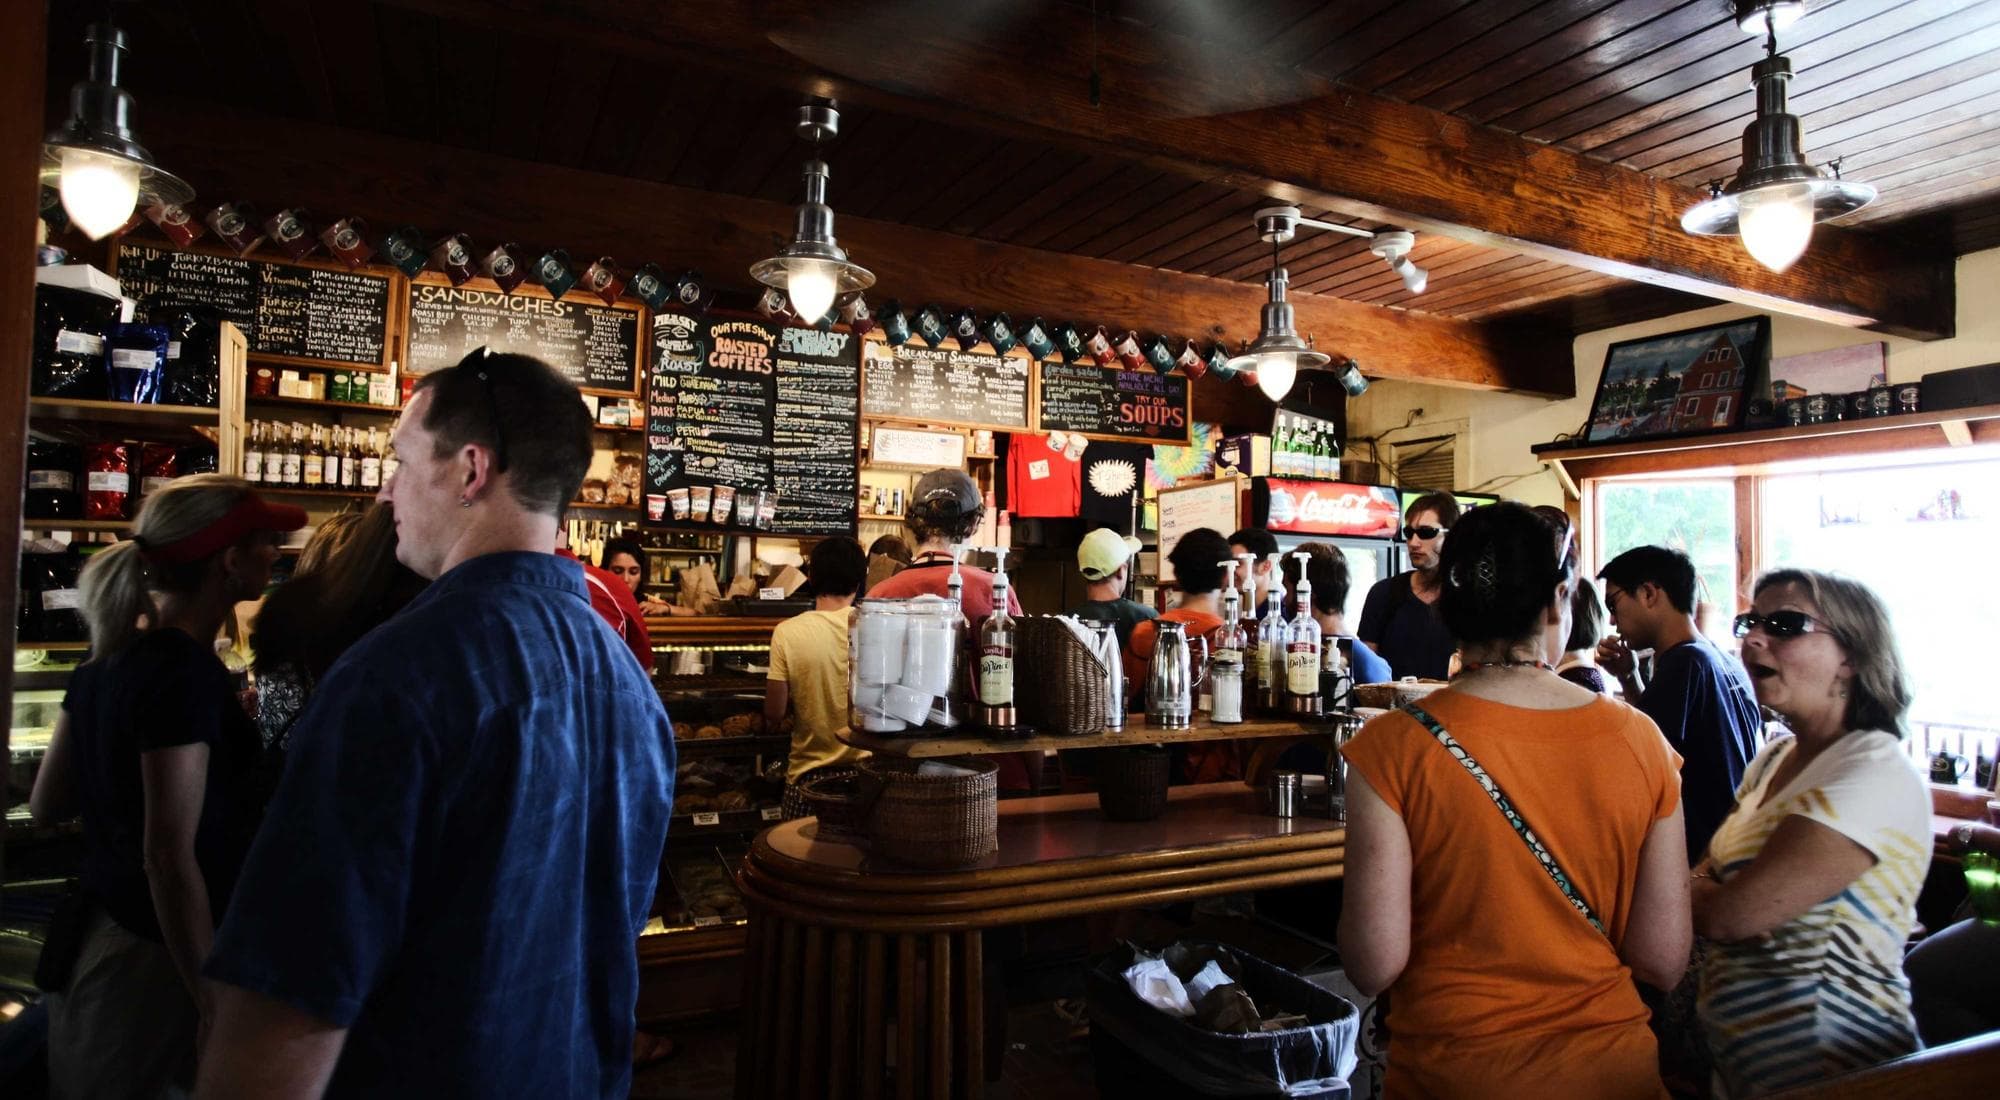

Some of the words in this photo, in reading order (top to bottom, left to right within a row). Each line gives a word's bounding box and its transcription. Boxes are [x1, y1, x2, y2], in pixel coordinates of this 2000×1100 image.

[416, 301, 442, 310] SERVED
[420, 286, 566, 318] SANDWICHES
[412, 308, 436, 318] ROAST
[436, 310, 456, 320] BEEF
[462, 313, 498, 322] CHICKEN
[416, 317, 448, 326] TURKEY
[508, 317, 530, 328] TUNA
[420, 327, 440, 335] HAM
[710, 322, 730, 338] OUR
[731, 322, 776, 348] FRESHLY
[715, 337, 768, 359] ROASTED
[896, 344, 948, 361] BREAKFAST
[949, 350, 1002, 366] SANDWICHES
[660, 358, 702, 374] ROAST
[709, 352, 773, 375] COFFEES
[878, 360, 894, 370] EGG
[606, 375, 627, 383] SAUCE
[652, 374, 677, 389] MILD
[1117, 372, 1142, 382] ENTIRE
[1143, 374, 1164, 384] MENU
[1152, 384, 1166, 393] ALL
[1135, 394, 1151, 406] TRY
[1152, 396, 1168, 406] OUR
[650, 405, 676, 417] DARK
[676, 404, 705, 416] PAPUA
[1120, 402, 1184, 428] SOUPS
[676, 426, 701, 437] PERU
